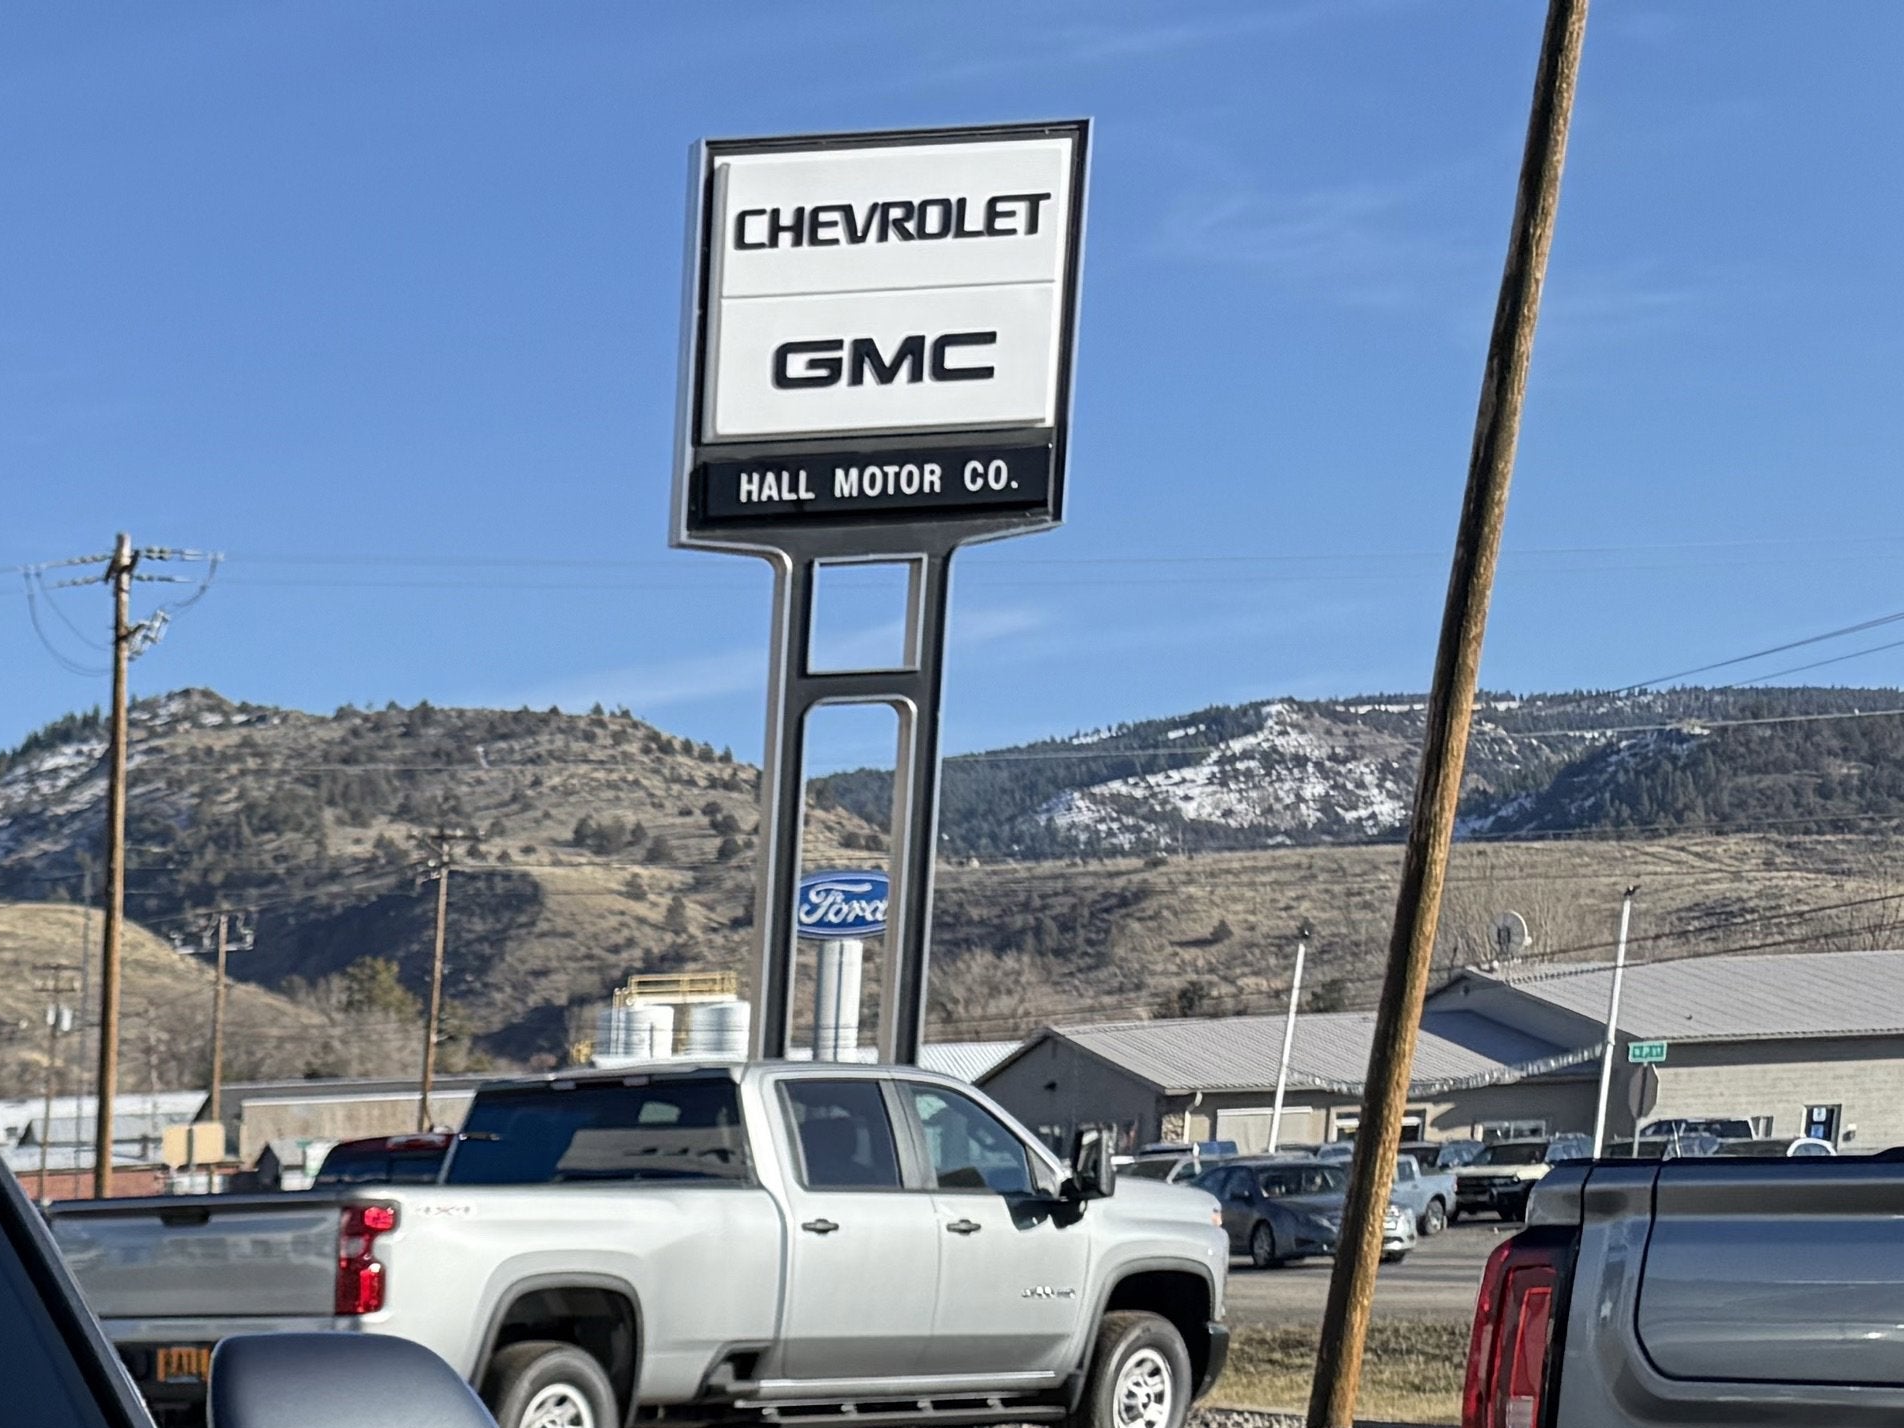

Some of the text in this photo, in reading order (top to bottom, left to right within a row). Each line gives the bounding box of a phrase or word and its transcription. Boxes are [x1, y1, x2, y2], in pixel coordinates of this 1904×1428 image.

[734, 191, 1052, 250] CHEVROLET
[772, 330, 998, 389] GMC
[739, 459, 1019, 503] HALL MOTOR CO.
[798, 881, 889, 924] Ford
